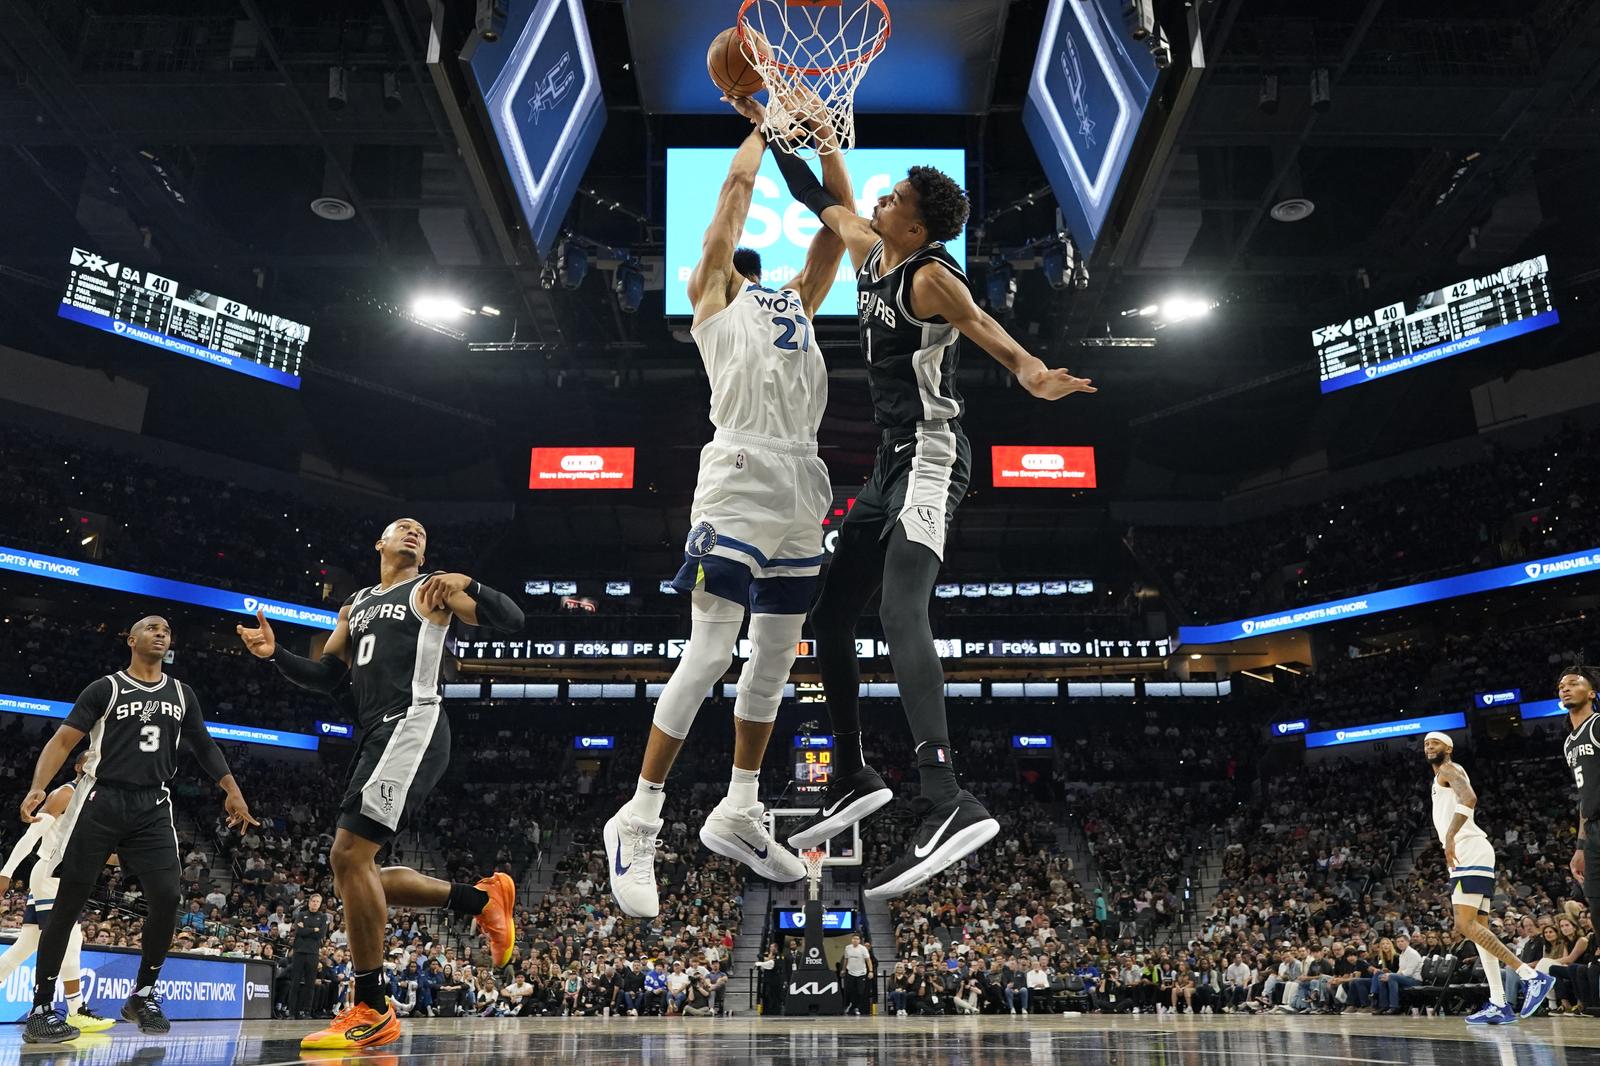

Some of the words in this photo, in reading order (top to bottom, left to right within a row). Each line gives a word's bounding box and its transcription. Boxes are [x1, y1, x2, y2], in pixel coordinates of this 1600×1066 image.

[736, 173, 890, 248] Sef
[121, 267, 141, 282] SA
[151, 276, 170, 293] 40
[1452, 283, 1468, 298] 42
[1475, 272, 1502, 291] MIN
[223, 301, 240, 316] 42
[245, 309, 272, 326] MIN
[1354, 315, 1372, 330] SA
[1382, 306, 1397, 321] 40
[772, 314, 809, 353] 27
[127, 327, 164, 345] FANDUEL
[165, 339, 195, 354] SPORTS
[195, 349, 233, 366] NETWORK
[865, 328, 872, 364] 1
[1378, 359, 1413, 374] FANDUEL
[1413, 348, 1442, 362] SPORTS
[1442, 337, 1481, 354] NETWORK
[28, 558, 80, 577] NETWORK
[1542, 556, 1593, 574] FANDUEL
[257, 603, 299, 618] FANDUEL
[300, 611, 331, 624] SPORTS
[1255, 616, 1293, 630] FANDUEL
[1293, 609, 1326, 621] SPORTS
[1326, 600, 1368, 616] NETWORK
[357, 633, 376, 666] 0
[535, 644, 554, 655] TO
[574, 643, 610, 655] FG%
[633, 643, 653, 655] PF
[965, 642, 985, 654] PF
[1002, 642, 1038, 654] FG%
[1060, 642, 1081, 654] TO
[17, 701, 51, 711] NETWORK
[116, 701, 182, 723] SPURS
[139, 724, 161, 753] 3
[230, 729, 252, 737] SPORTS
[252, 732, 279, 741] NETWORK
[1393, 723, 1421, 732] NETWORK
[805, 752, 830, 764] 9:10
[809, 763, 828, 783] 15
[1574, 765, 1585, 789] 5
[805, 956, 823, 965] Frost
[154, 979, 192, 1001] SPORTS
[193, 982, 237, 1001] NETWORK
[789, 981, 839, 995] KIA
